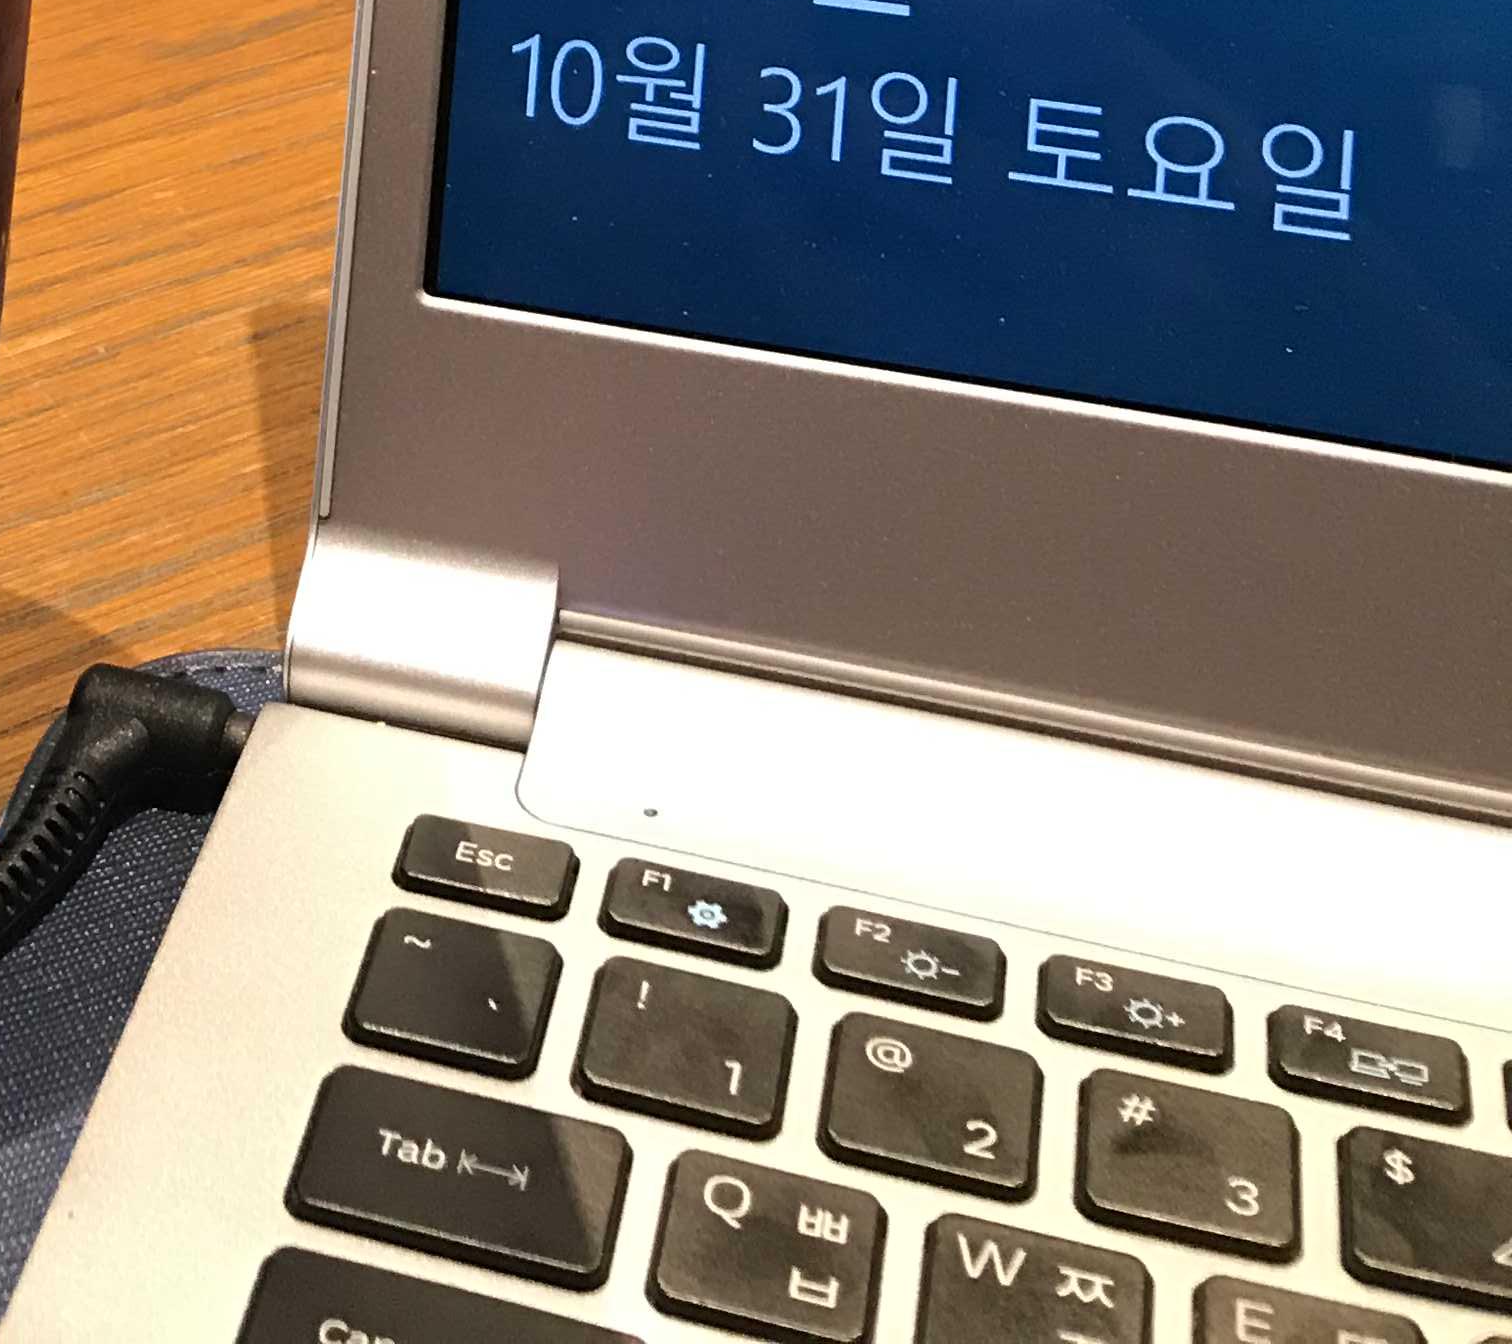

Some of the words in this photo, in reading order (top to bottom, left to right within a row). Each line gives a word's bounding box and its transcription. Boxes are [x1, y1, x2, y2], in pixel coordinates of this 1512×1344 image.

[511, 33, 706, 150] 10월
[752, 66, 958, 185] 31일
[1007, 97, 1354, 241] 토요일
[641, 869, 673, 892] F1
[855, 918, 892, 943] F2
[1075, 967, 1115, 992] F3
[1303, 1015, 1347, 1043] F4
[865, 1037, 913, 1073] @
[724, 1060, 742, 1096] 1
[1118, 1094, 1157, 1126] #
[379, 1128, 447, 1170] Tab
[963, 1120, 998, 1160] 2
[1383, 1149, 1416, 1185] $
[703, 1175, 752, 1230] Q
[1226, 1177, 1260, 1217] 3
[957, 1232, 1028, 1287] W
[788, 1265, 840, 1309] ㅂ
[1235, 1298, 1274, 1344] E
